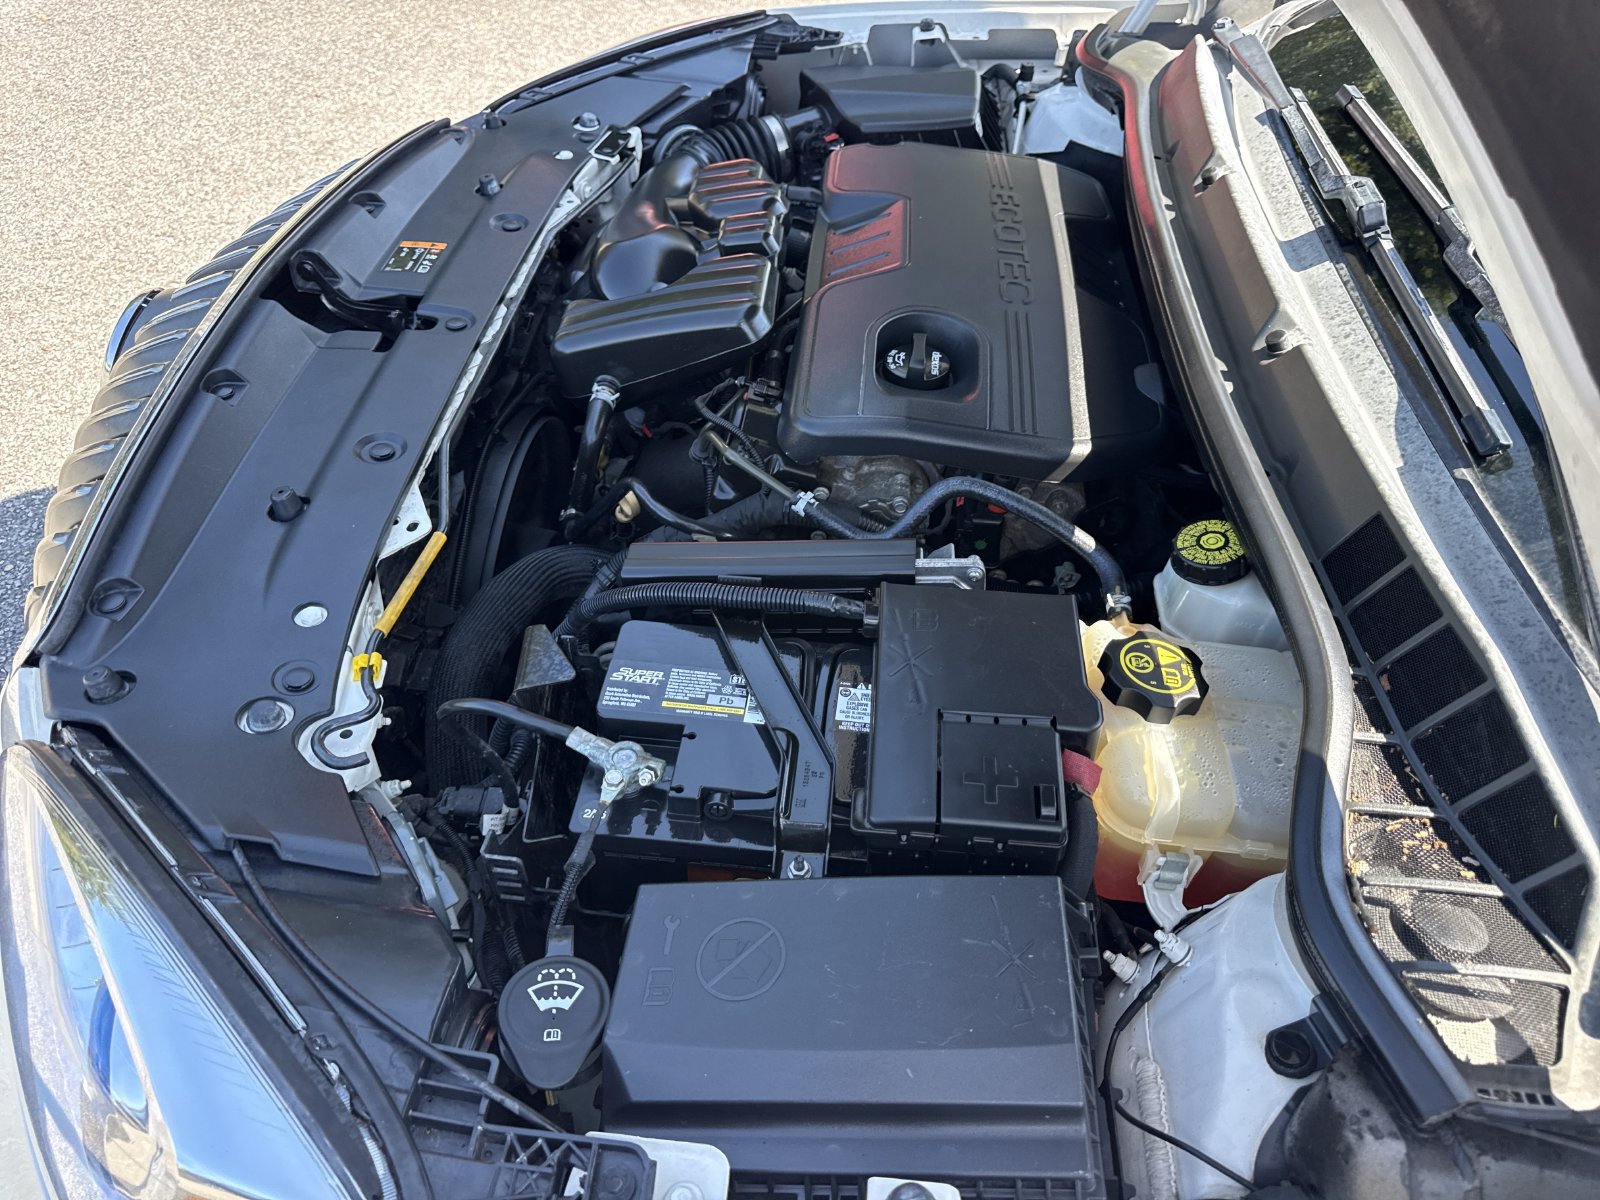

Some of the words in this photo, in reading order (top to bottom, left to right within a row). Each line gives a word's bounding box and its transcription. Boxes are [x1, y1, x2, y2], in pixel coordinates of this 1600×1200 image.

[990, 187, 1033, 306] ECOTEC
[931, 351, 943, 376] dexos
[609, 672, 664, 685] START
[619, 667, 665, 678] SUPER
[719, 697, 734, 705] Pb
